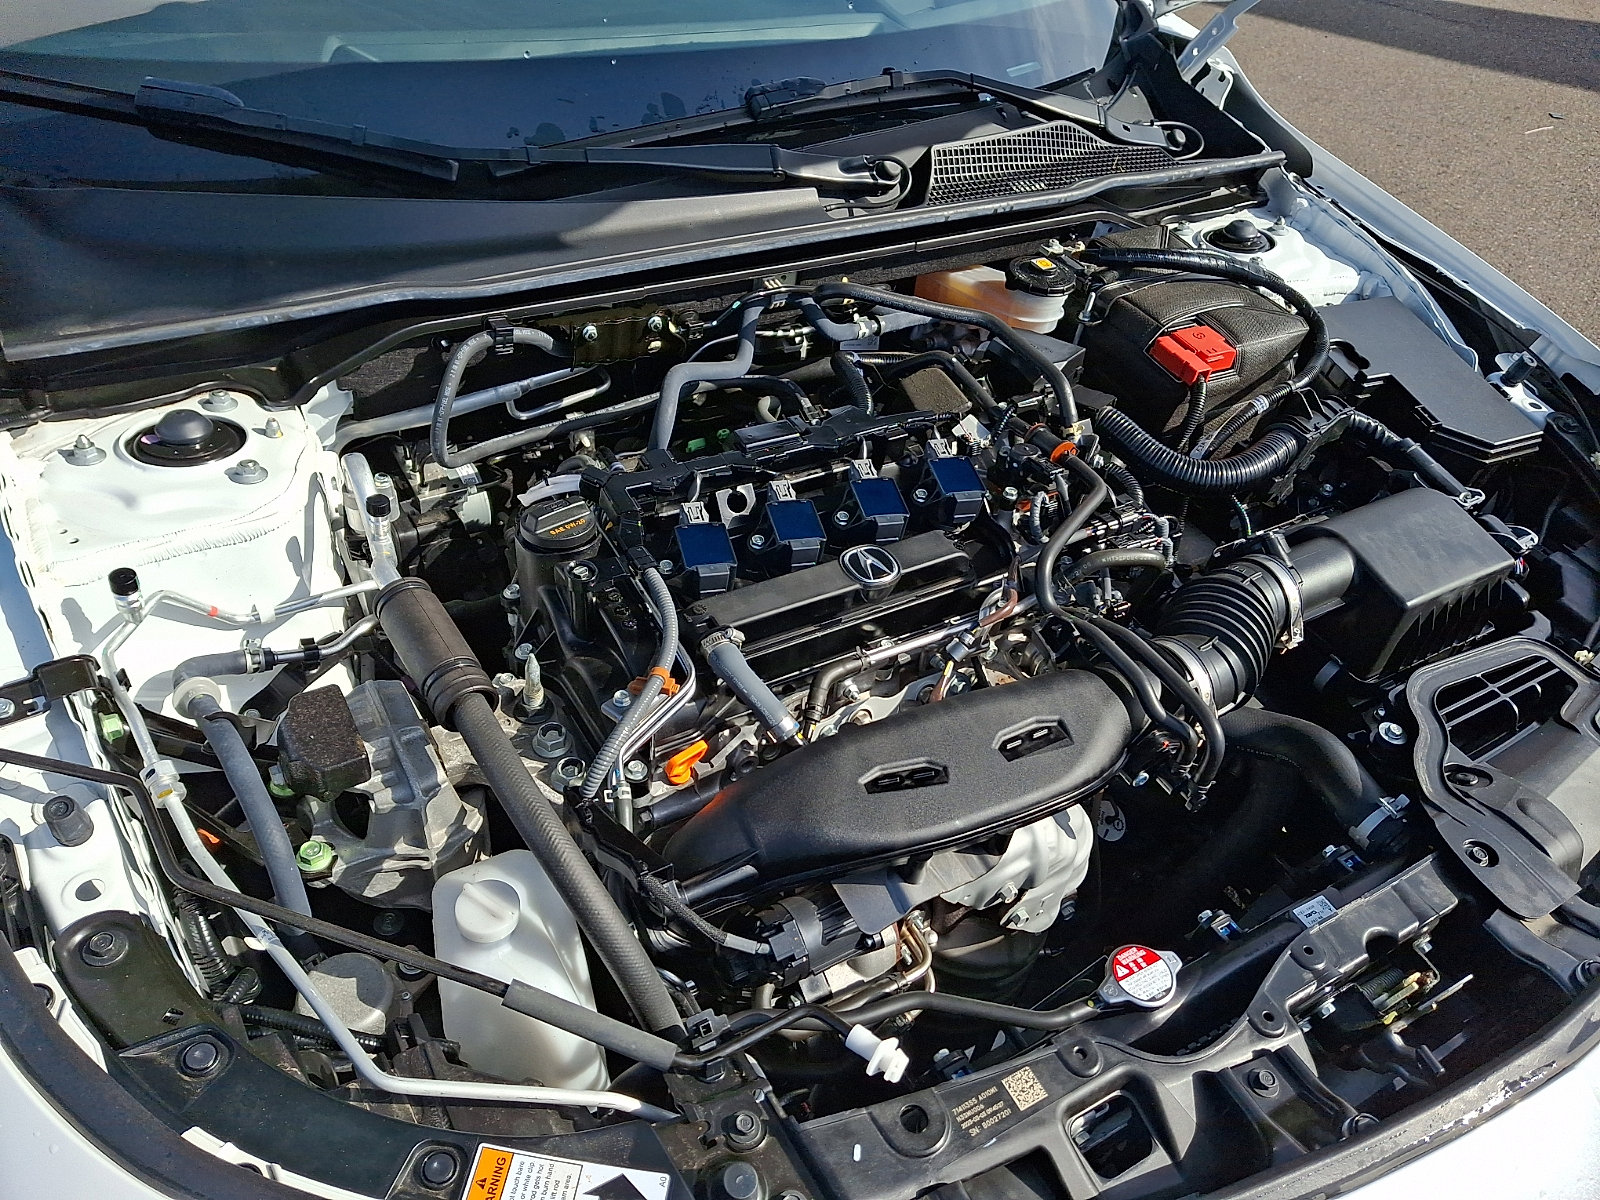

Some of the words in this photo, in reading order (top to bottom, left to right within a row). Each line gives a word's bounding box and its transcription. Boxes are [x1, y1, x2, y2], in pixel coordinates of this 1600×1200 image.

[549, 526, 565, 535] SAE
[511, 1176, 520, 1194] touch
[516, 1161, 525, 1175] bare
[545, 1163, 555, 1180] hand
[522, 1174, 531, 1191] white
[533, 1175, 541, 1190] gets
[541, 1180, 550, 1195] burn
[553, 1180, 561, 1191] rod
